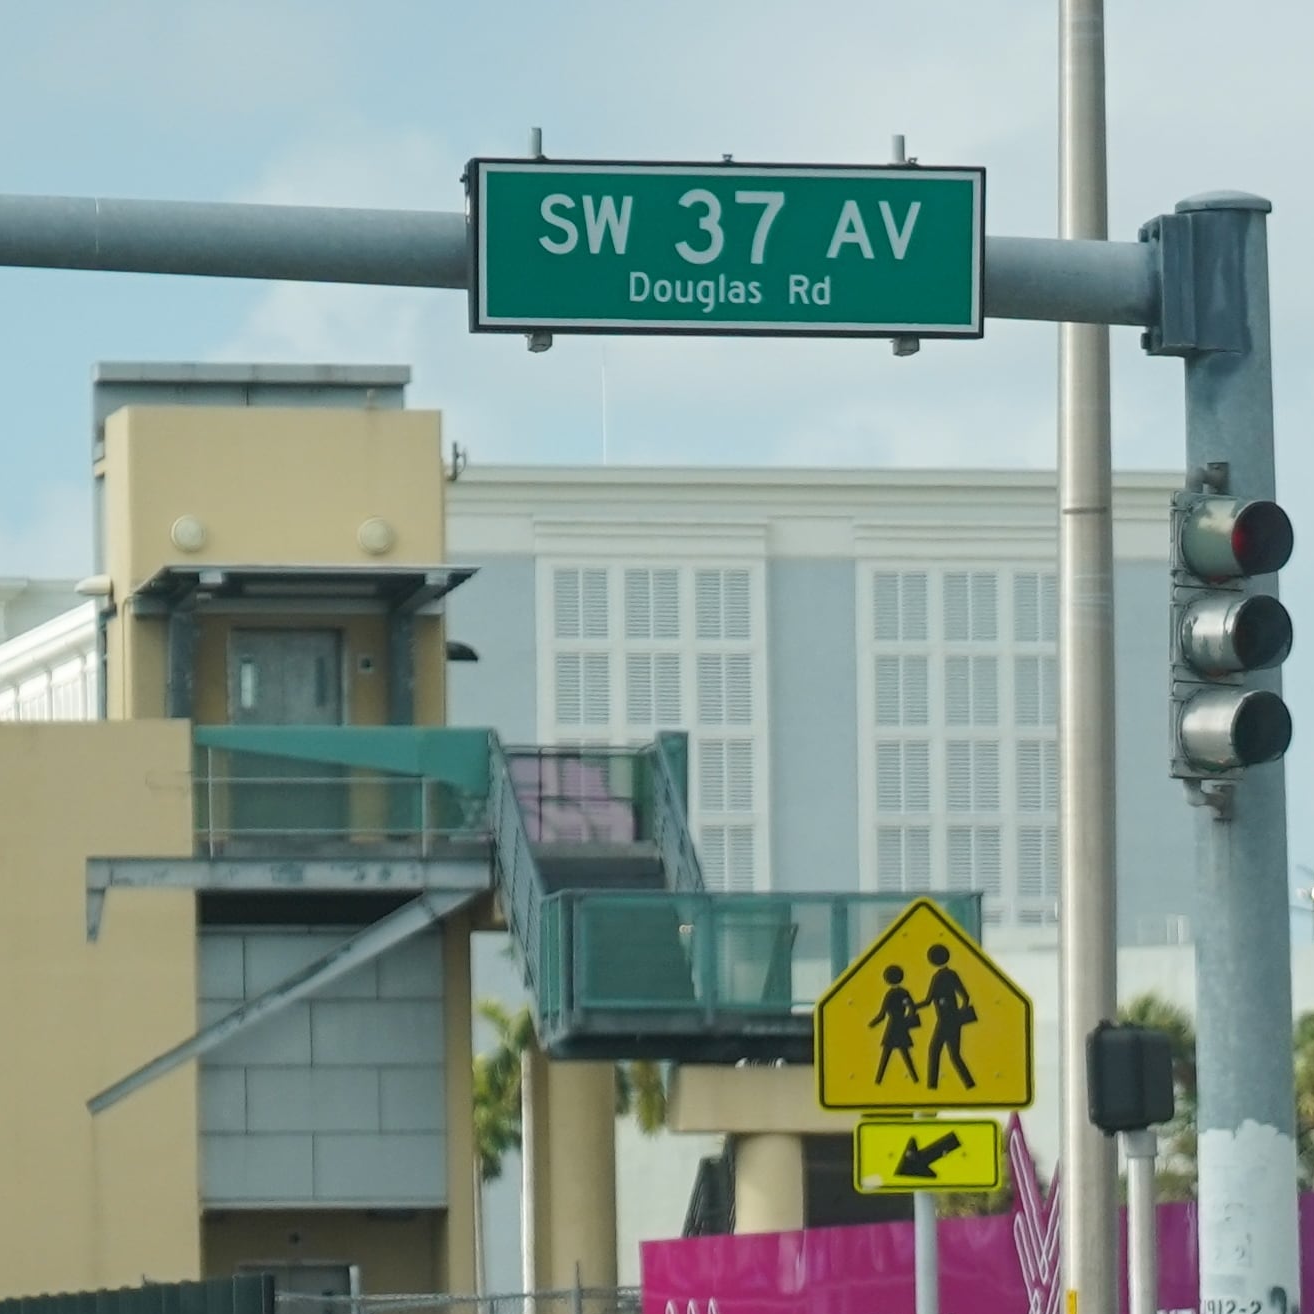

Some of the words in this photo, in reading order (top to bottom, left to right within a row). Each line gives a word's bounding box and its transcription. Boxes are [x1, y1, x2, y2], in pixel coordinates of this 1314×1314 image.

[538, 192, 633, 257] SW
[674, 188, 786, 266] 37
[826, 199, 922, 261] AV
[628, 270, 763, 313] Douglas
[788, 273, 832, 306] Rd
